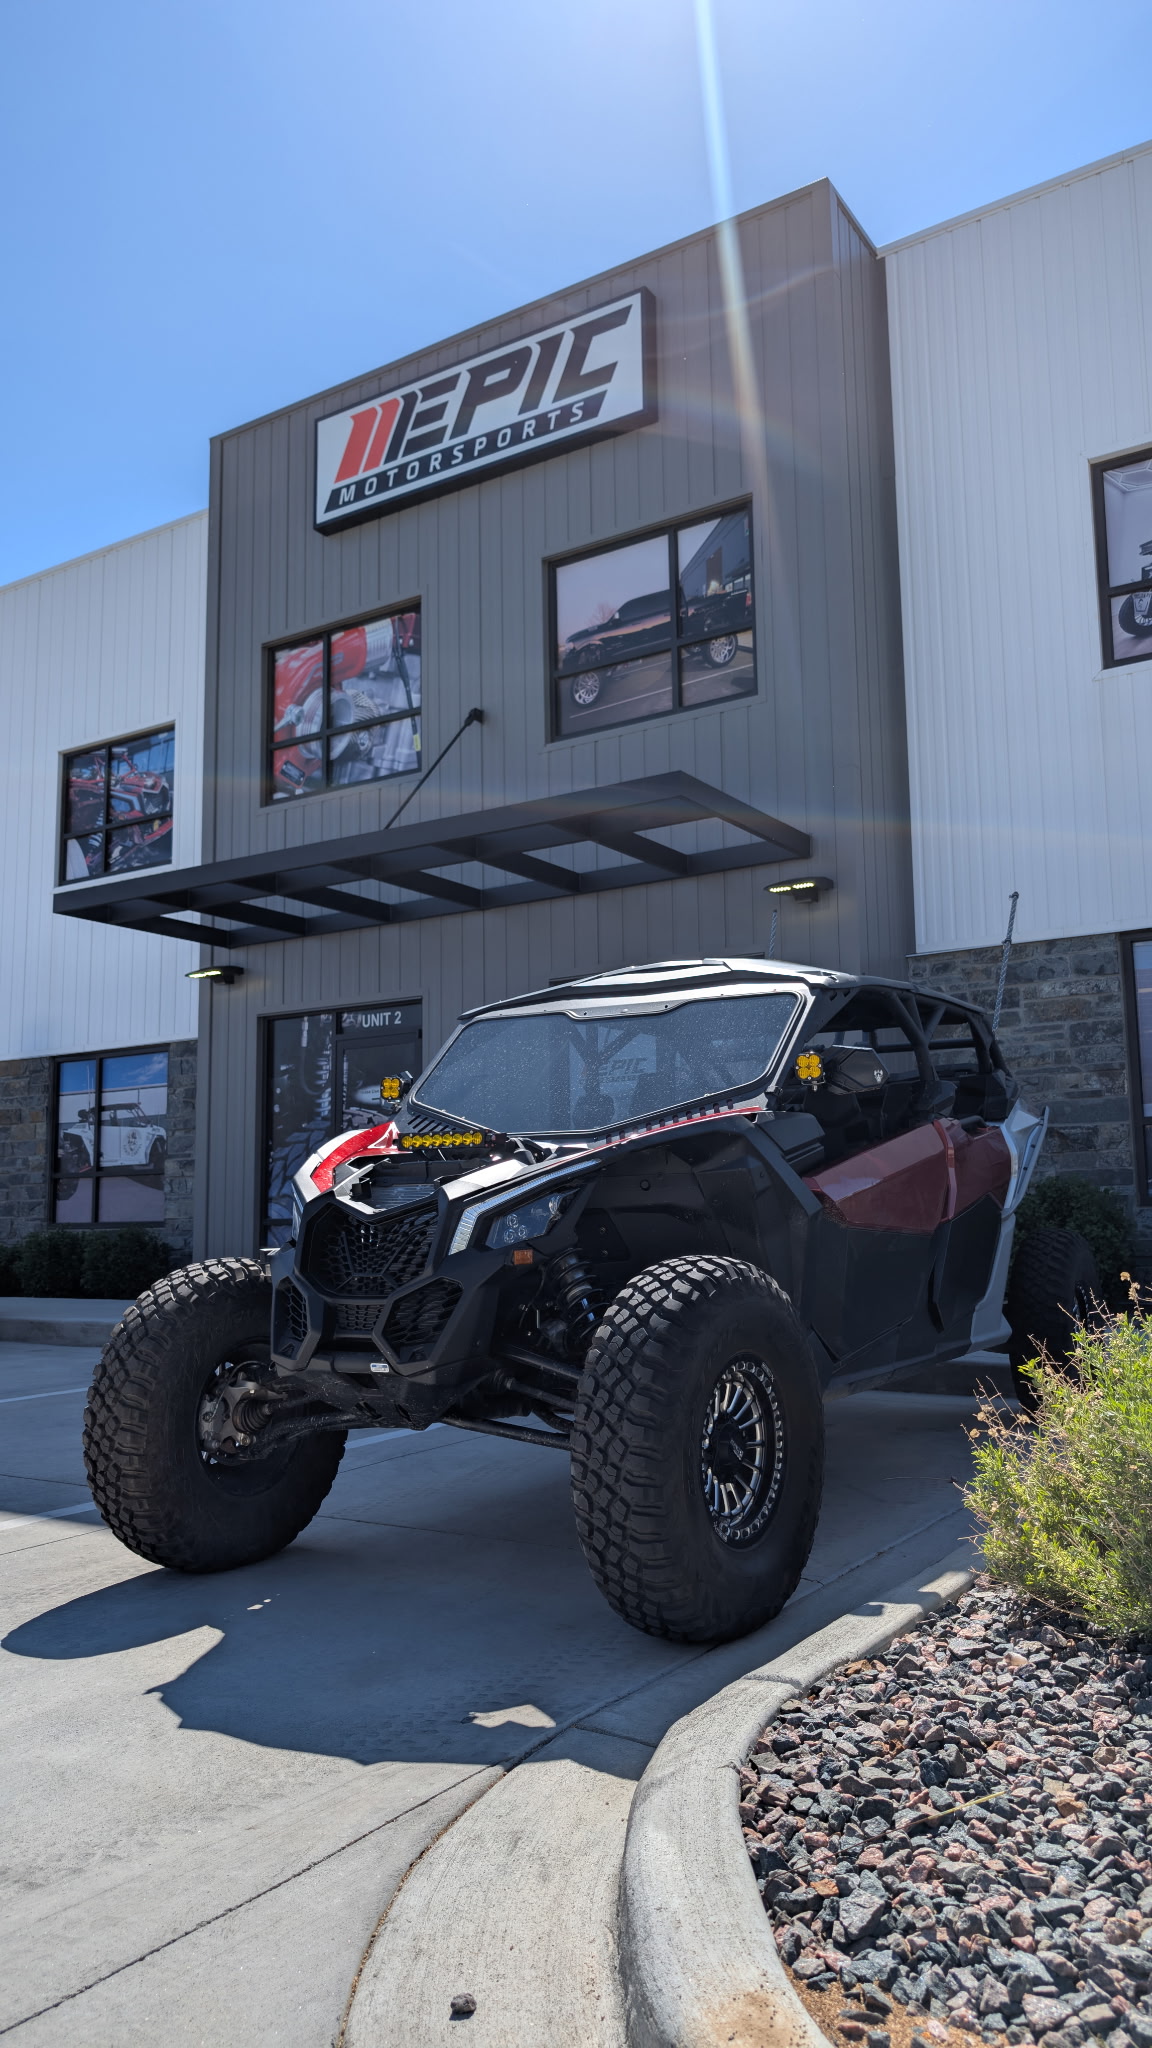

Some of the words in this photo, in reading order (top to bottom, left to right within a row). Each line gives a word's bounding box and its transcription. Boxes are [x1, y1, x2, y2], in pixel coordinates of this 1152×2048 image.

[400, 304, 633, 458] EPIC
[338, 401, 585, 506] MOTORSPORTS
[362, 1012, 391, 1028] UNIT
[394, 1011, 402, 1025] 2
